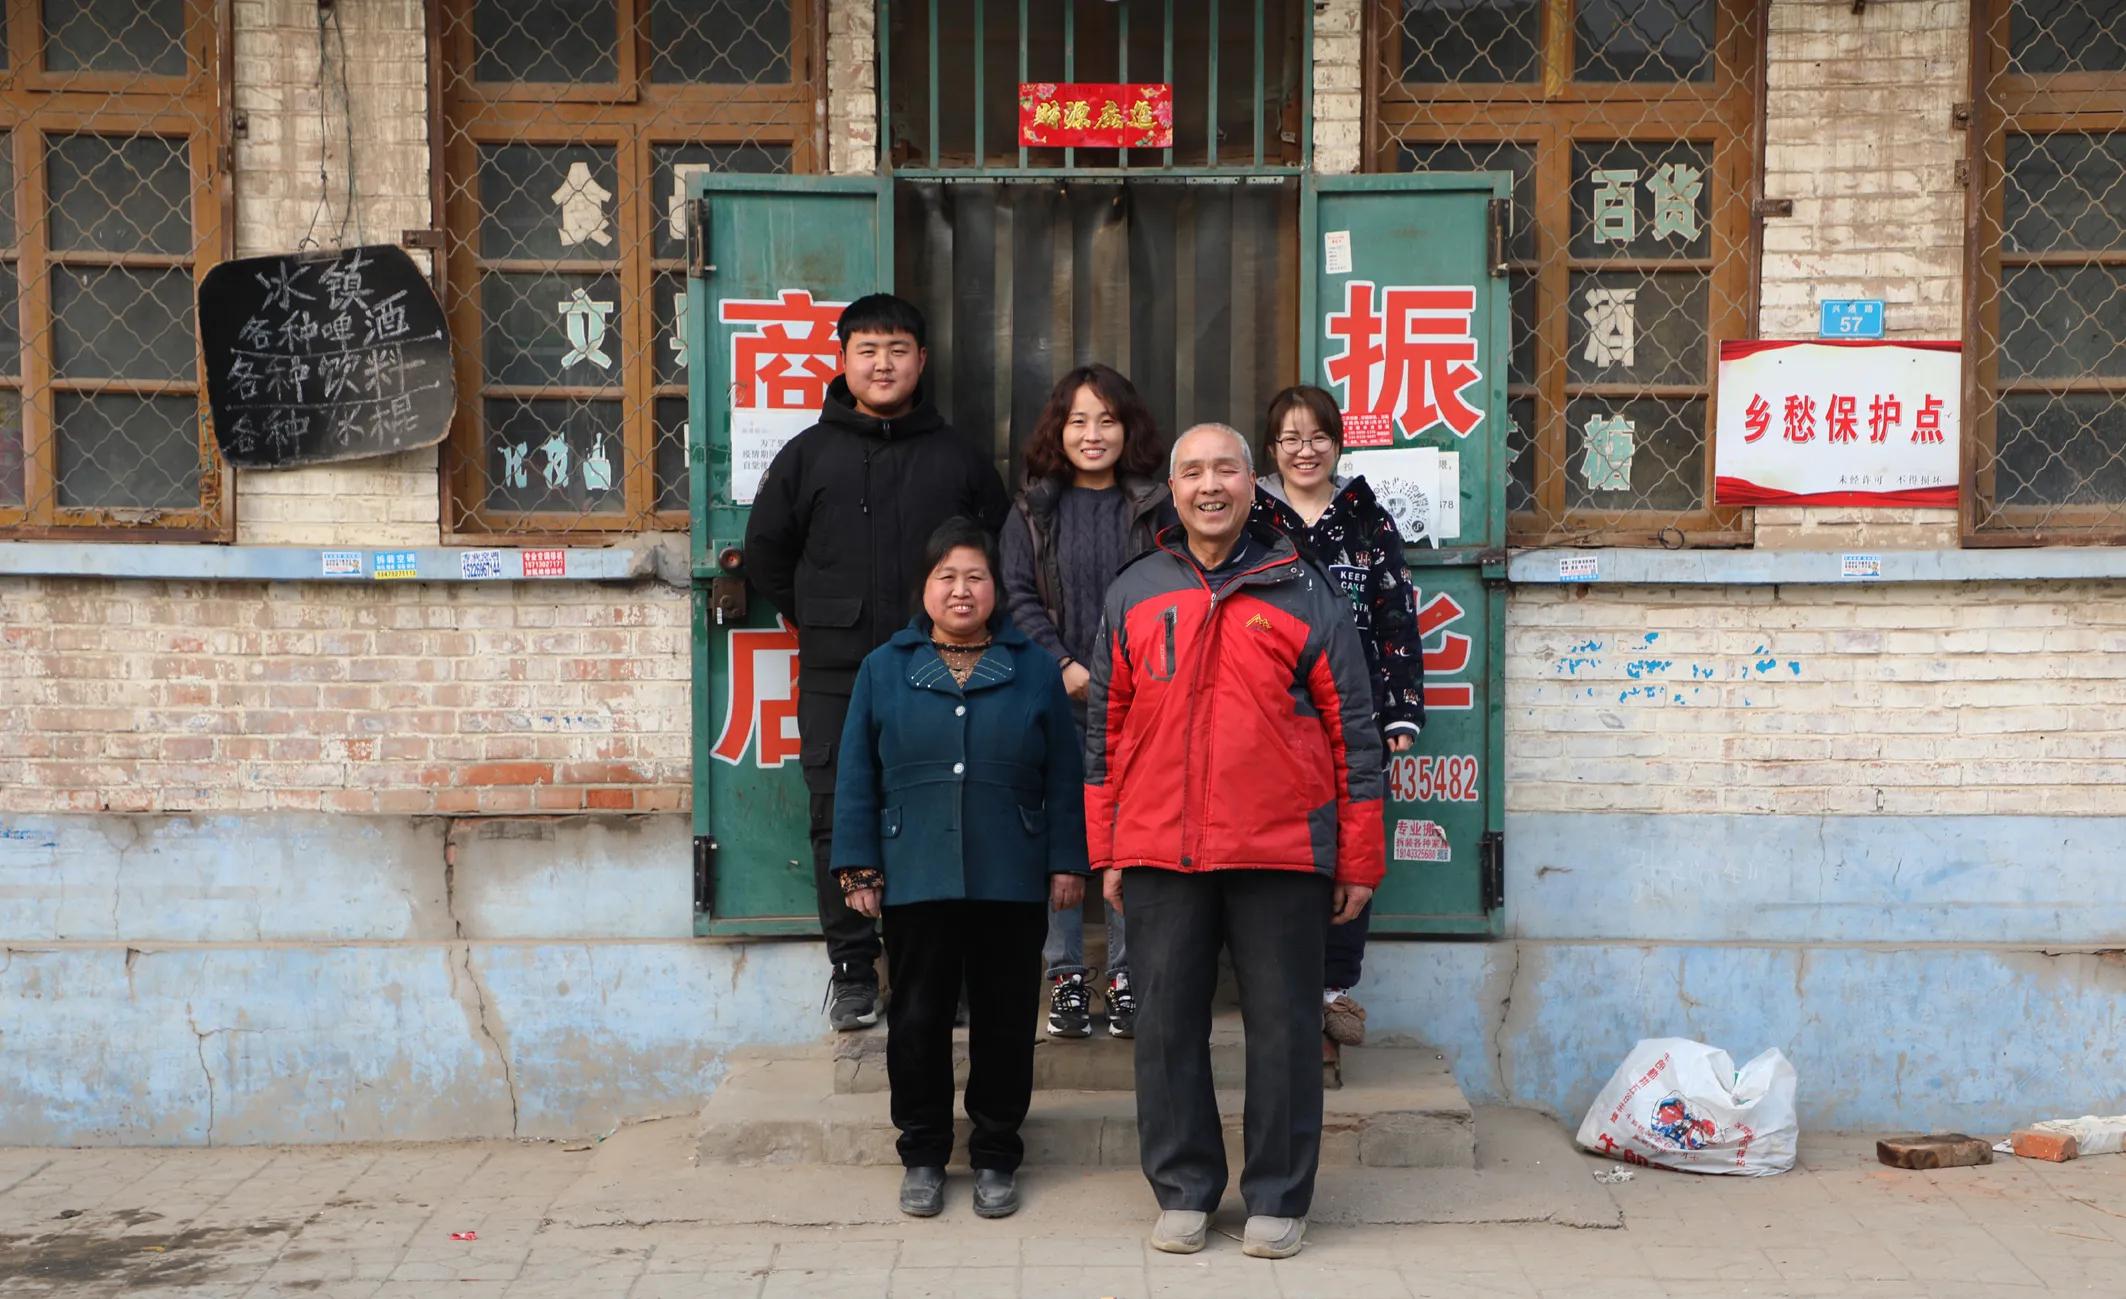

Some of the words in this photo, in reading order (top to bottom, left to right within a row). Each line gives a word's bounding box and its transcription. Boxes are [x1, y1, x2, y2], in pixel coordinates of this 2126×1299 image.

[1591, 163, 1703, 243] 百货
[239, 290, 410, 350] 各种啤酒
[1584, 288, 1636, 367] 酒
[1840, 316, 1864, 333] 57
[227, 343, 426, 402] 各种饮料
[1323, 280, 1485, 439] 振
[1743, 393, 1946, 444] 乡愁保护点
[1340, 571, 1367, 581] KEEP
[1340, 581, 1365, 592] CAKE
